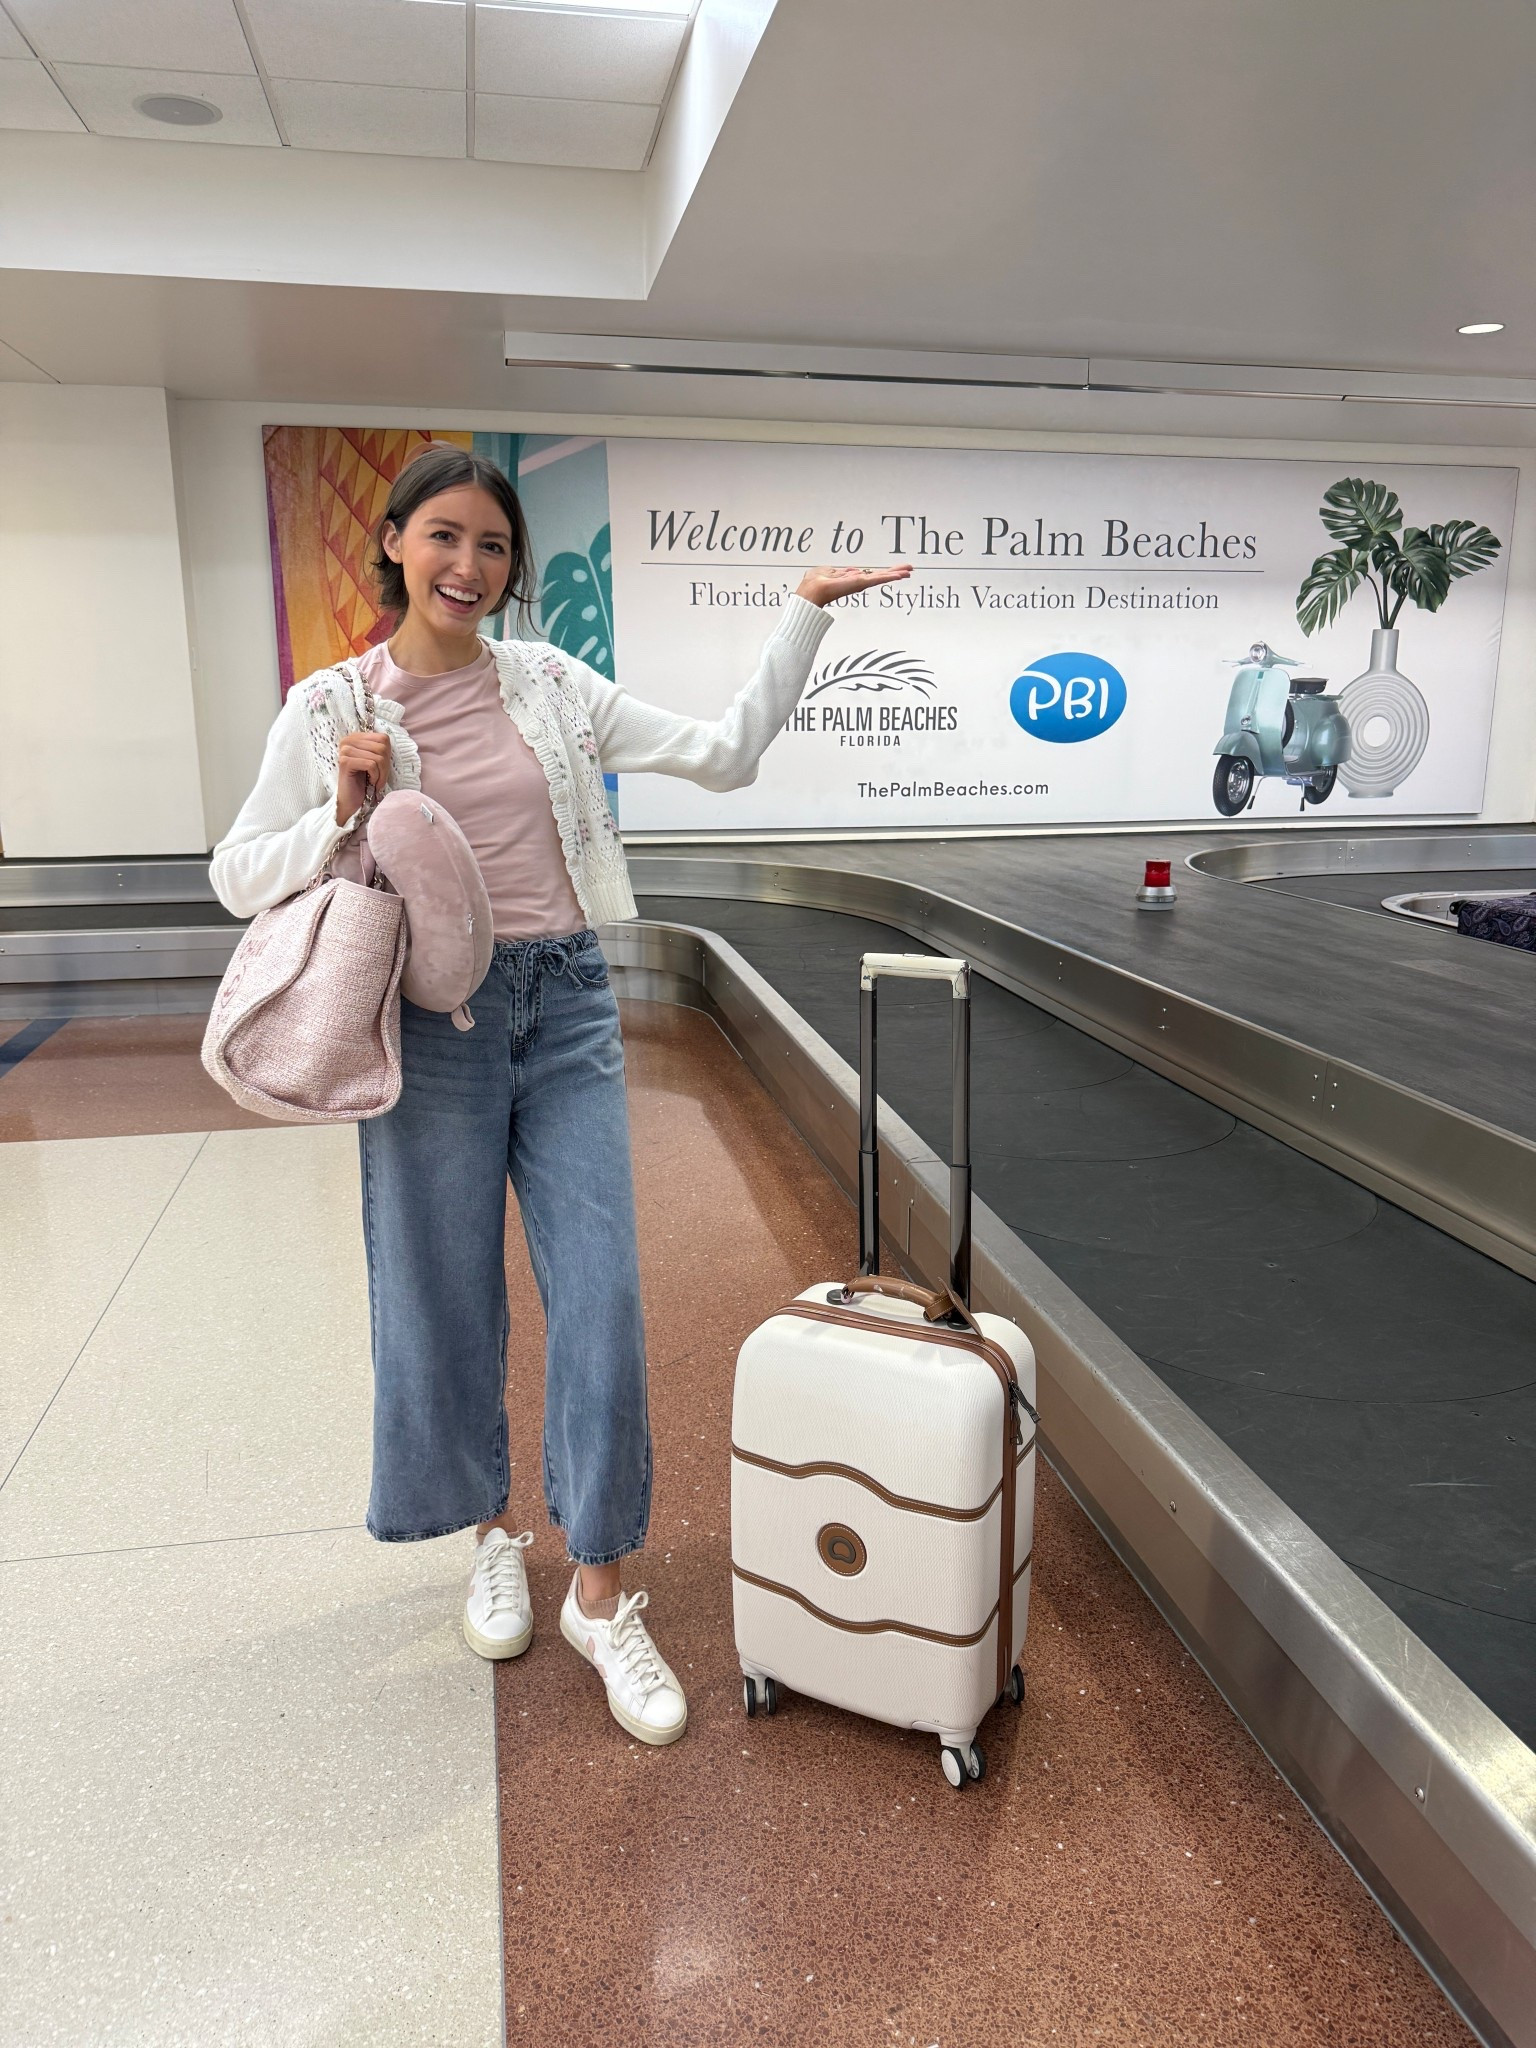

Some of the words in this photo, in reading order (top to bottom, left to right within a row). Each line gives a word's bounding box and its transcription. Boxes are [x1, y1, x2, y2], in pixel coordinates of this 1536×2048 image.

[646, 509, 813, 554] Welcome
[830, 520, 864, 554] to
[881, 515, 964, 556] The
[981, 517, 1085, 557] Palm
[1100, 519, 1257, 560] Beaches
[689, 582, 796, 608] Florida'
[823, 589, 870, 608] ost
[879, 585, 960, 616] Stylish
[970, 586, 1076, 610] Vacation
[1085, 587, 1219, 611] Destination
[1021, 670, 1108, 720] PBI
[822, 706, 873, 732] PALM
[879, 706, 958, 732] BEACHES
[840, 735, 901, 747] FLORIDA
[857, 780, 1049, 798] ThePalmBeaches.com
